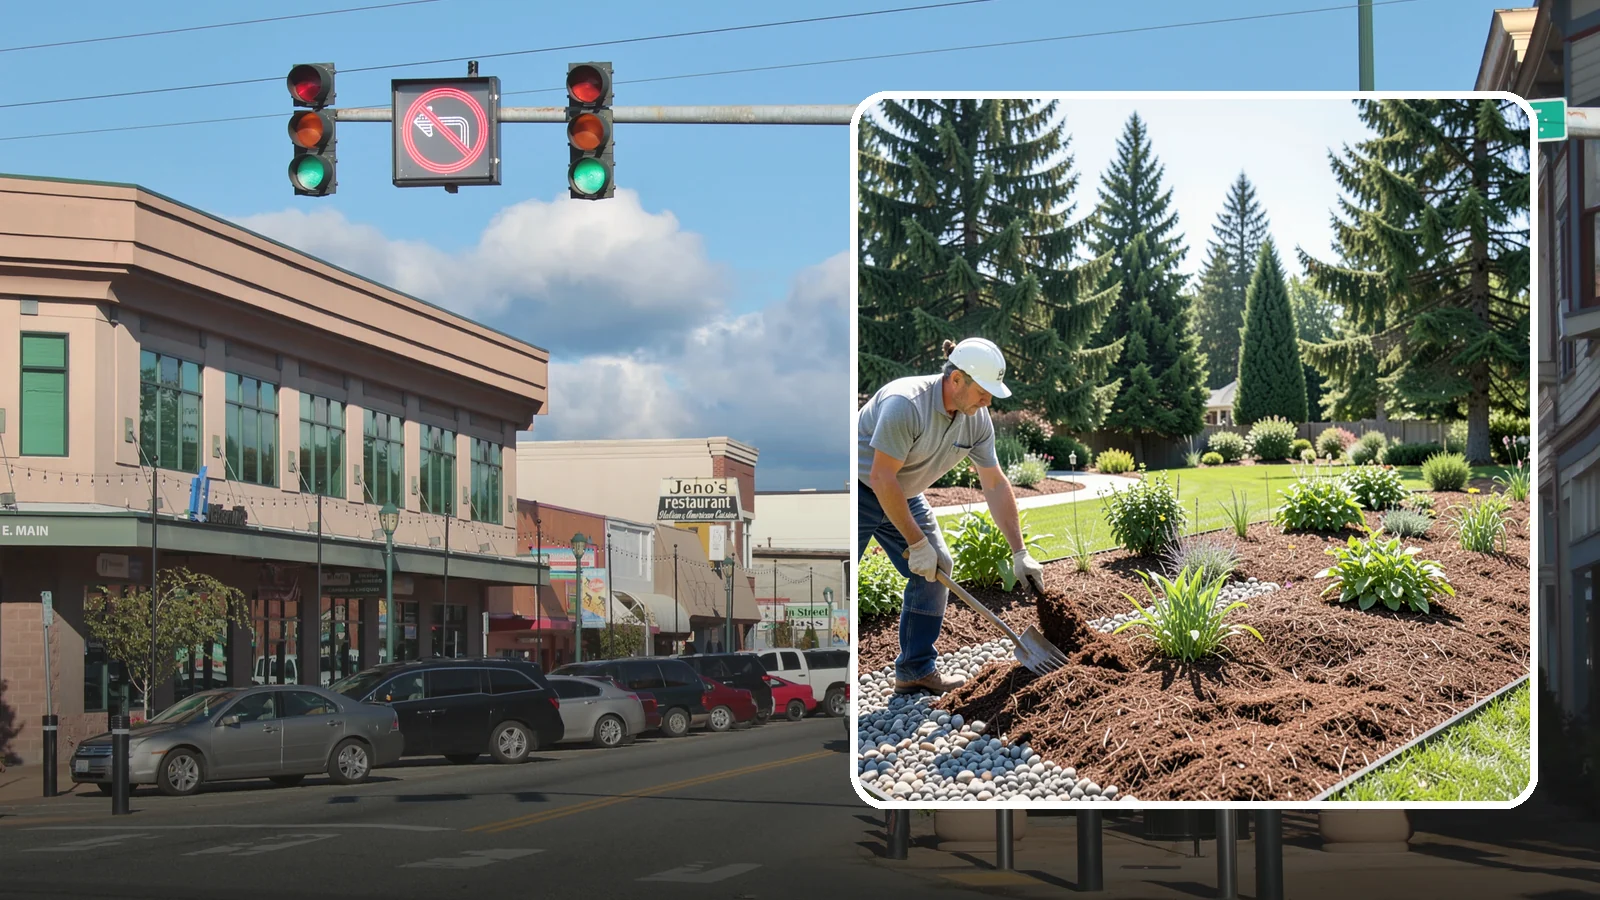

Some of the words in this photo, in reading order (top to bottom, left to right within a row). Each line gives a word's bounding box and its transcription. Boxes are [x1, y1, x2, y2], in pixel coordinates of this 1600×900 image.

[669, 480, 727, 494] Jeno's
[665, 496, 731, 509] restaurant
[659, 510, 681, 519] Italian
[686, 510, 714, 519] American
[715, 510, 737, 519] Cuisine
[2, 525, 13, 536] E.
[15, 525, 49, 536] MAIN
[797, 607, 829, 616] Street
[790, 619, 824, 627] lass
